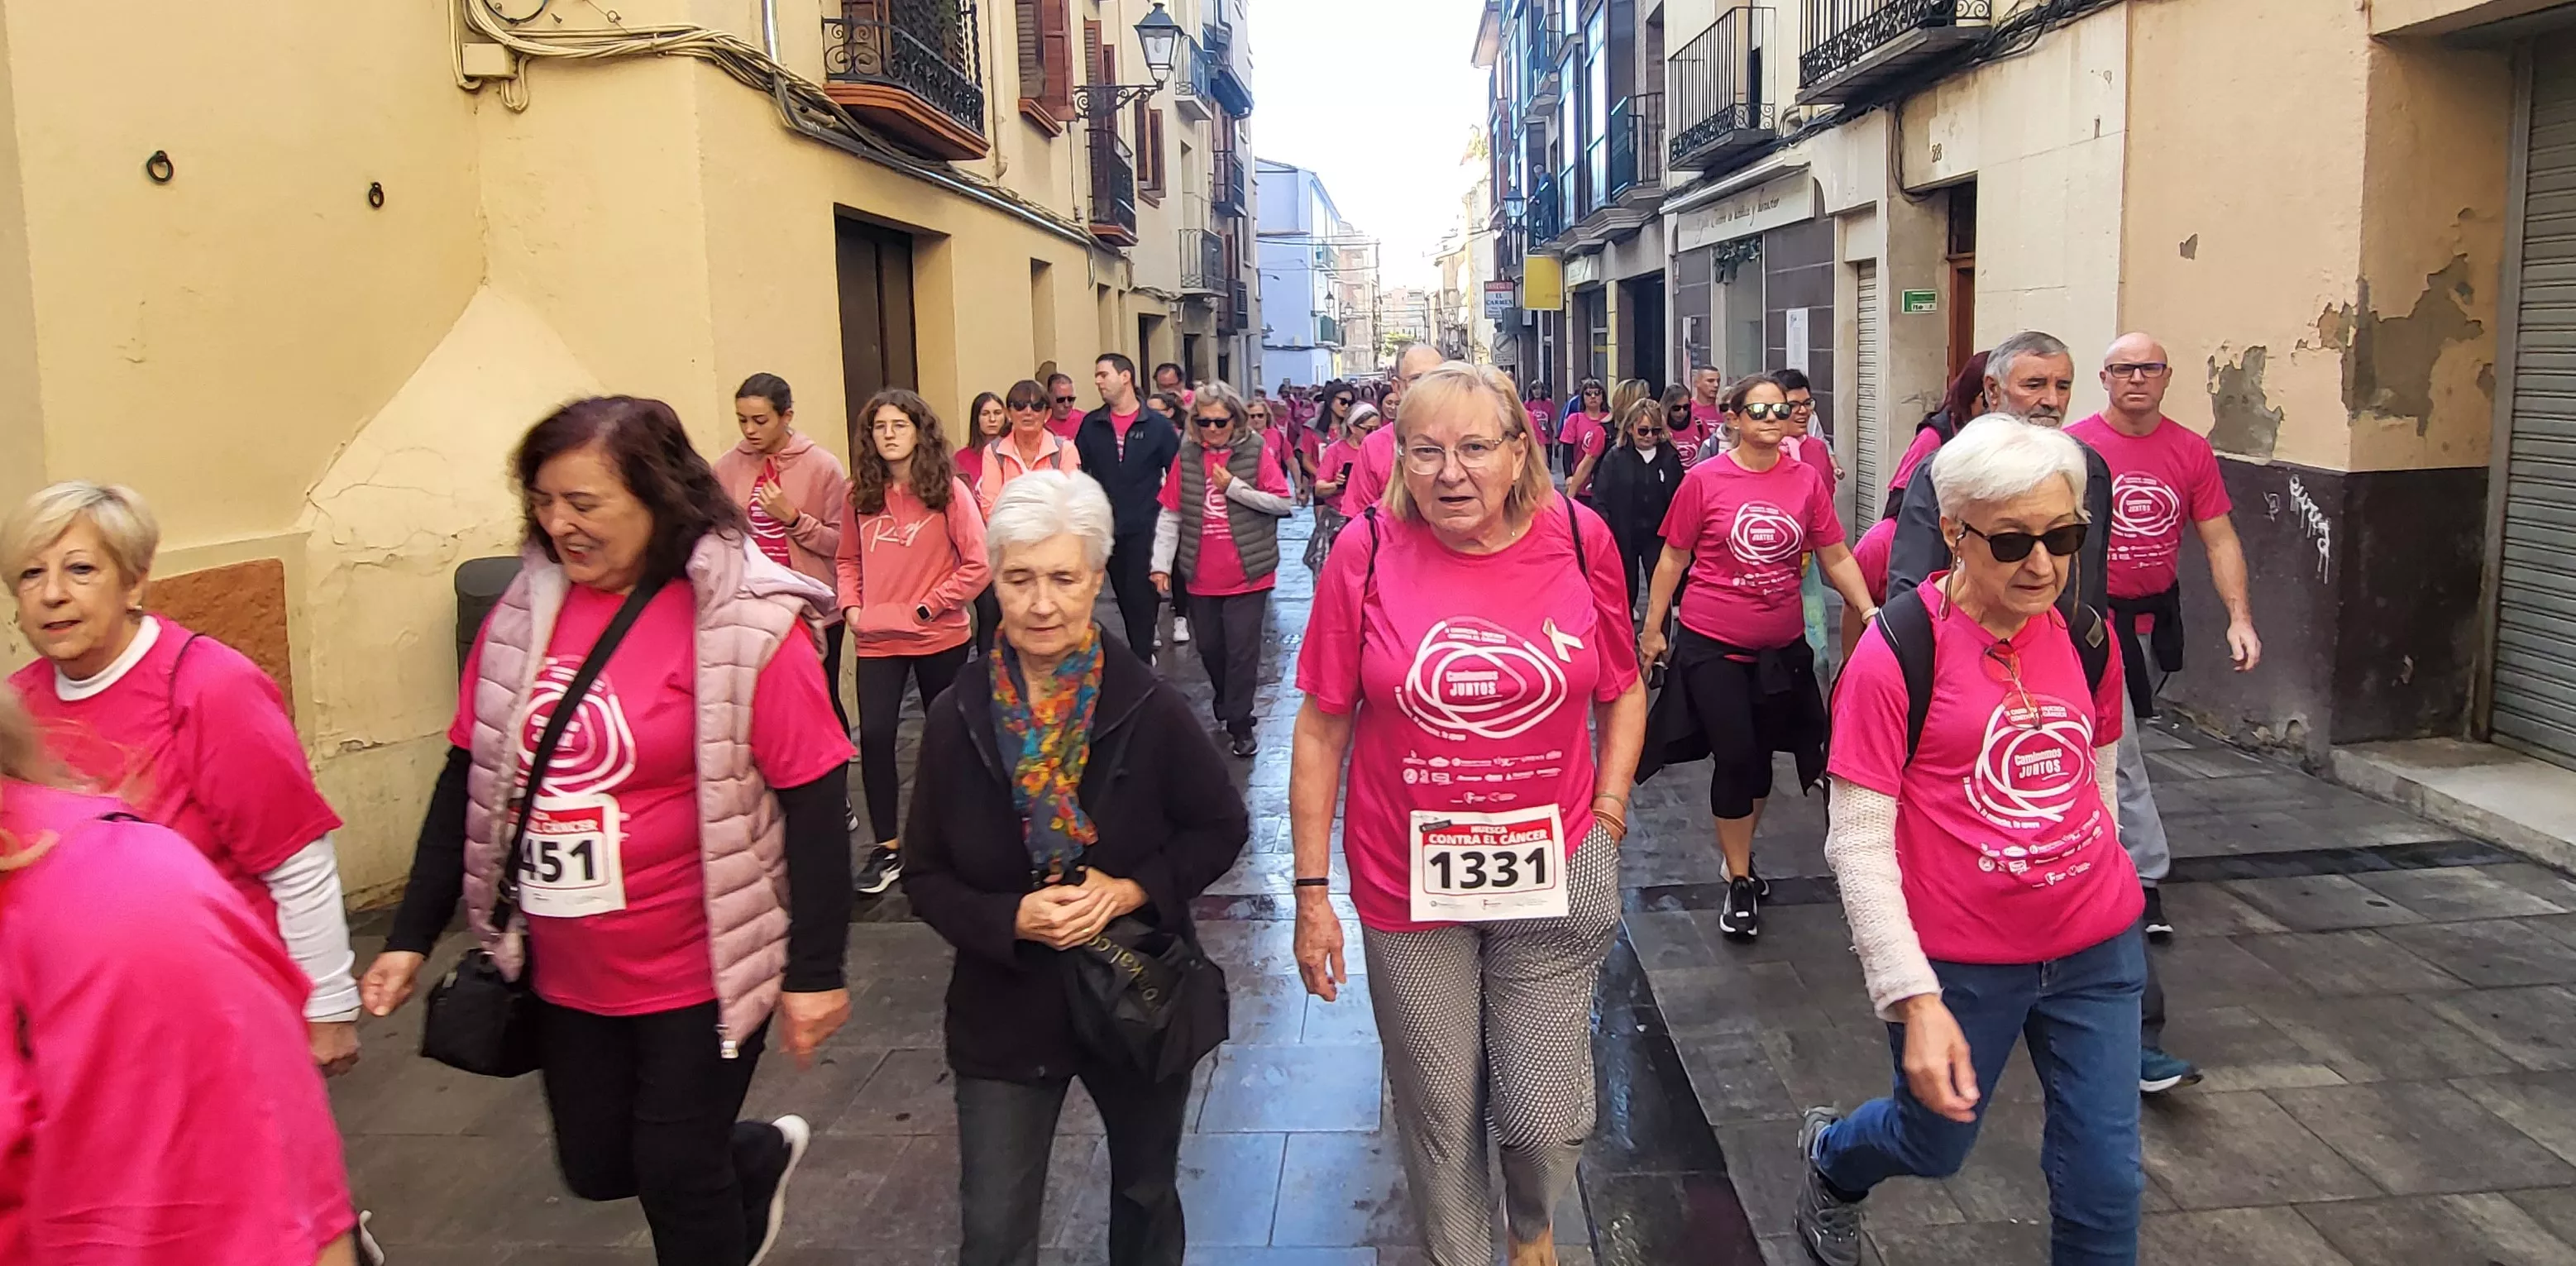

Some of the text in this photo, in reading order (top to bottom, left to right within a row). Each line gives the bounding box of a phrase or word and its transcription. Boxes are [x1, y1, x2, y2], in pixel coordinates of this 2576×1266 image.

[1449, 681, 1496, 697] JUNTOS
[2019, 758, 2062, 779] JUNTOS
[1428, 829, 1548, 845] CONTRA EL CÁNCER
[1429, 846, 1546, 890] 1331
